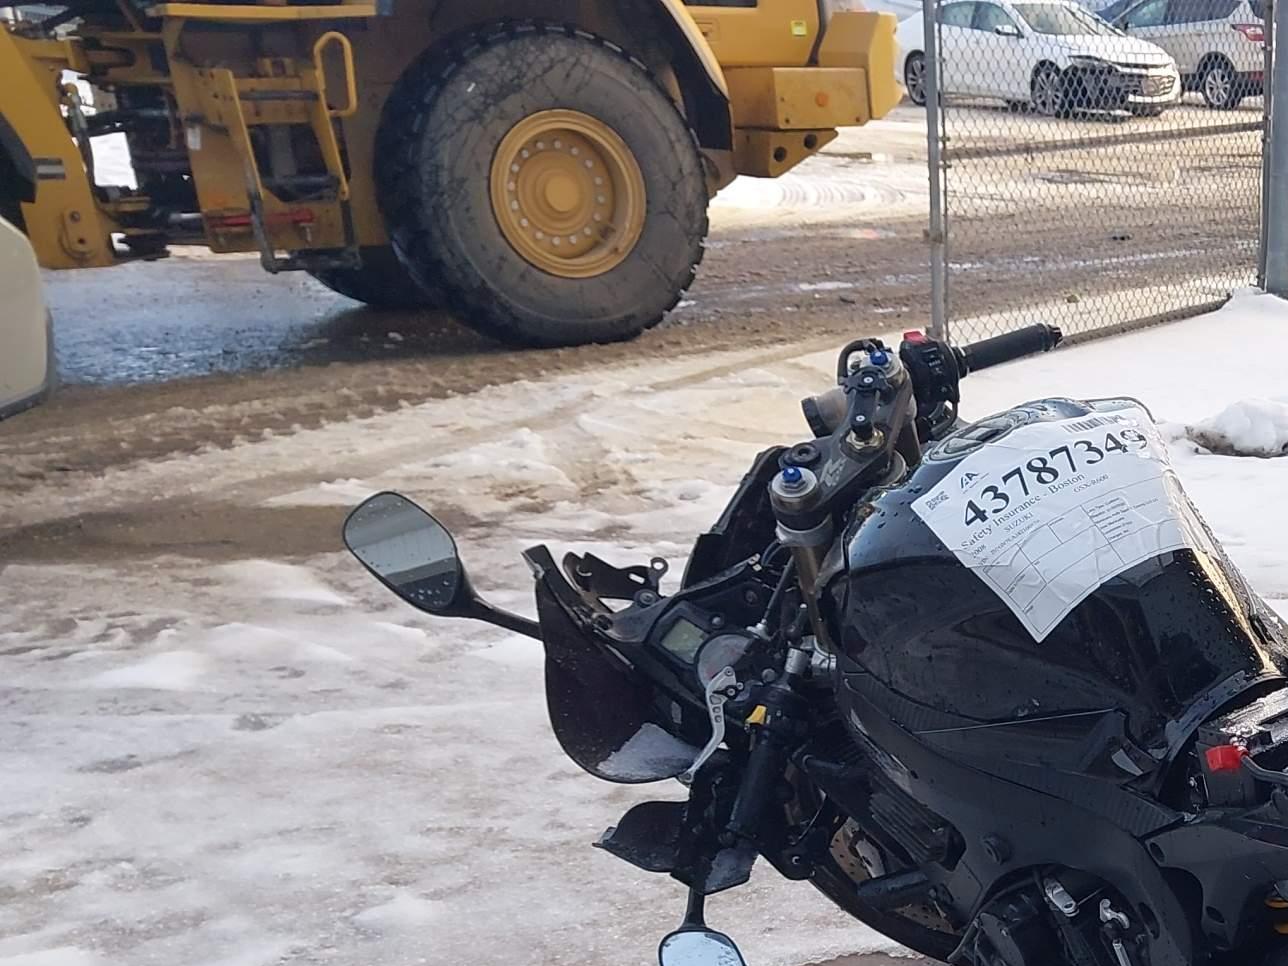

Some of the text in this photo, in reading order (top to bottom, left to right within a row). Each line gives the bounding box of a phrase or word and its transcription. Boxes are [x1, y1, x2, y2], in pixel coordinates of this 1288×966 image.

[960, 525, 993, 550] Safety
[993, 495, 1041, 527] Insurance
[1048, 474, 1085, 494] Boston
[965, 429, 1147, 526] 43787349
[1004, 512, 1034, 533] SUZUKI
